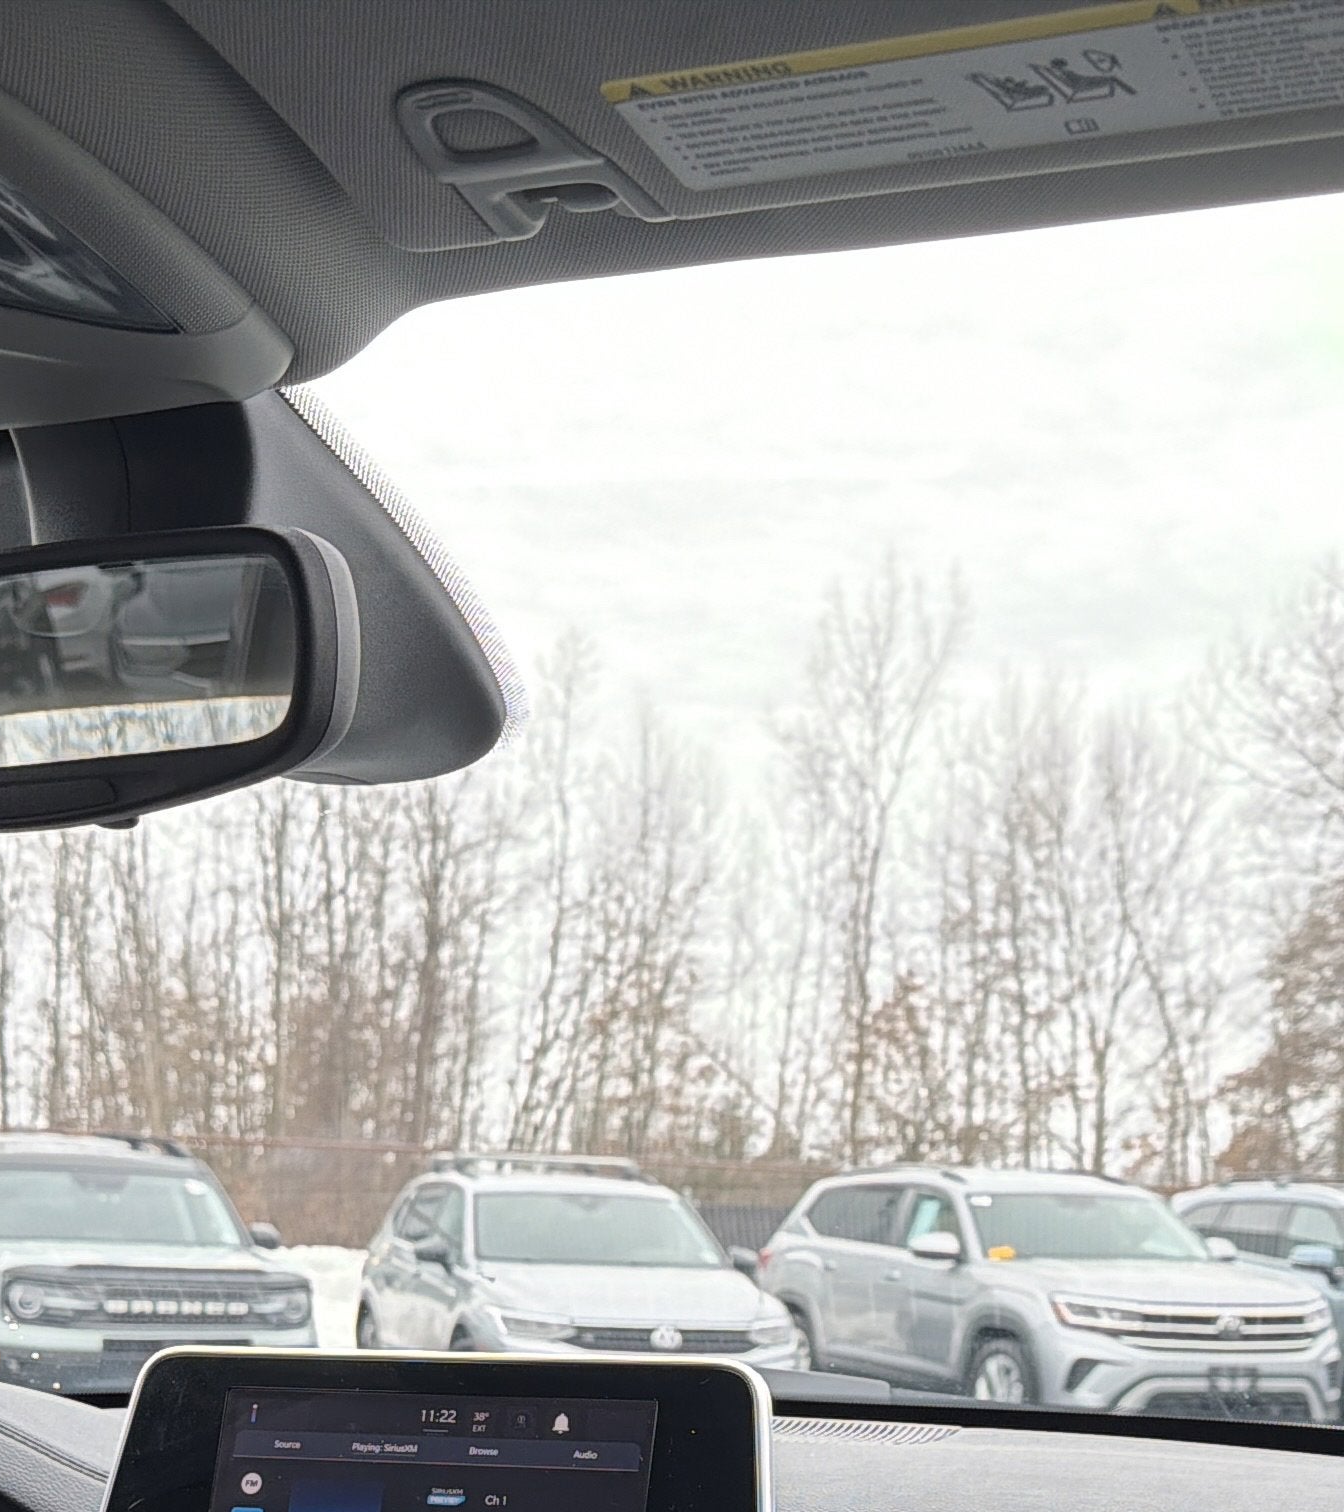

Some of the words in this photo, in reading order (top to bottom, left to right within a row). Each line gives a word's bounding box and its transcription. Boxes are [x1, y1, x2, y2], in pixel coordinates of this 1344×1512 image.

[661, 61, 793, 90] WARNING
[104, 1300, 249, 1316] BRONCO
[420, 1409, 456, 1424] 11:22
[472, 1424, 487, 1432] EXT
[274, 1439, 302, 1450] Source
[352, 1441, 383, 1453] Playing:
[383, 1443, 418, 1453] SiriusXM
[468, 1446, 499, 1456] Browse
[573, 1450, 598, 1460] Audio
[244, 1479, 258, 1487] FM
[485, 1495, 500, 1506] Ch
